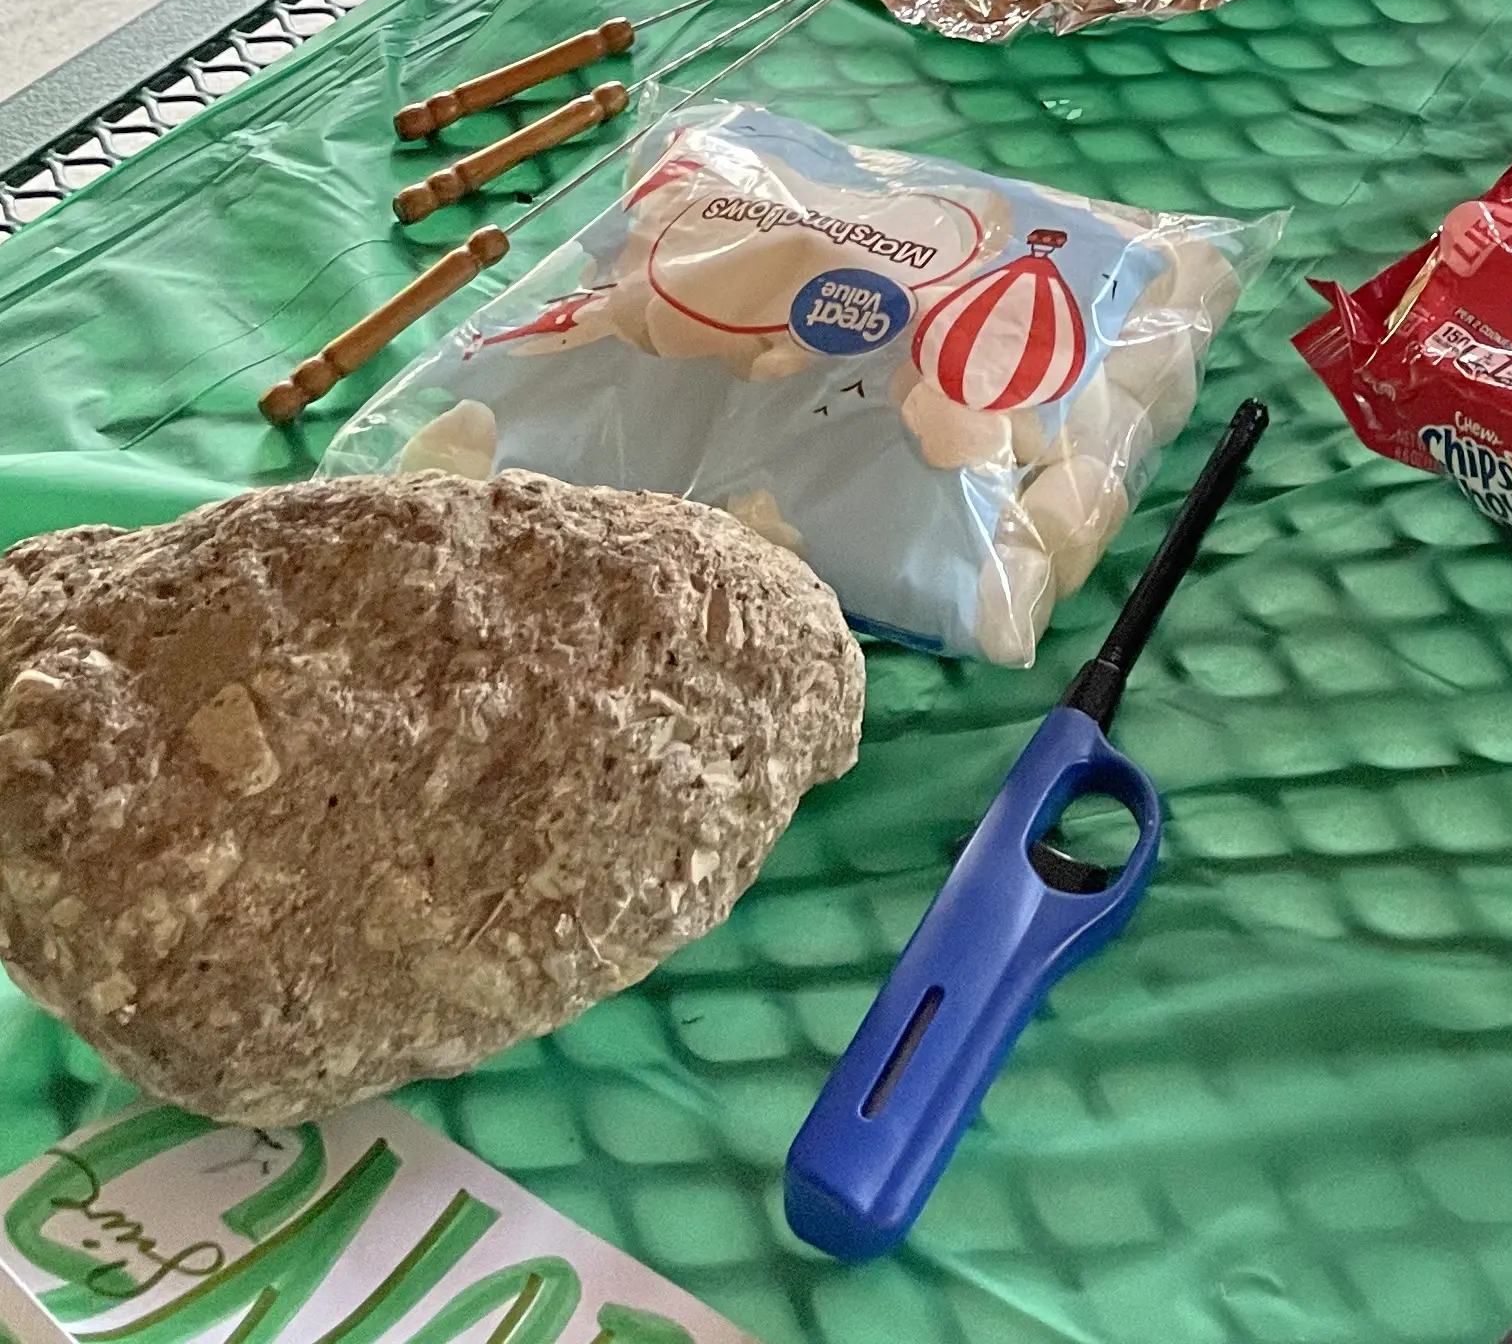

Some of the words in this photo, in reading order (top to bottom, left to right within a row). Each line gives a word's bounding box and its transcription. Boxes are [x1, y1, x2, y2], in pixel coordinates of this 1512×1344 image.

[703, 197, 937, 269] Marshmallows
[821, 281, 882, 312] Value
[806, 298, 891, 342] Great
